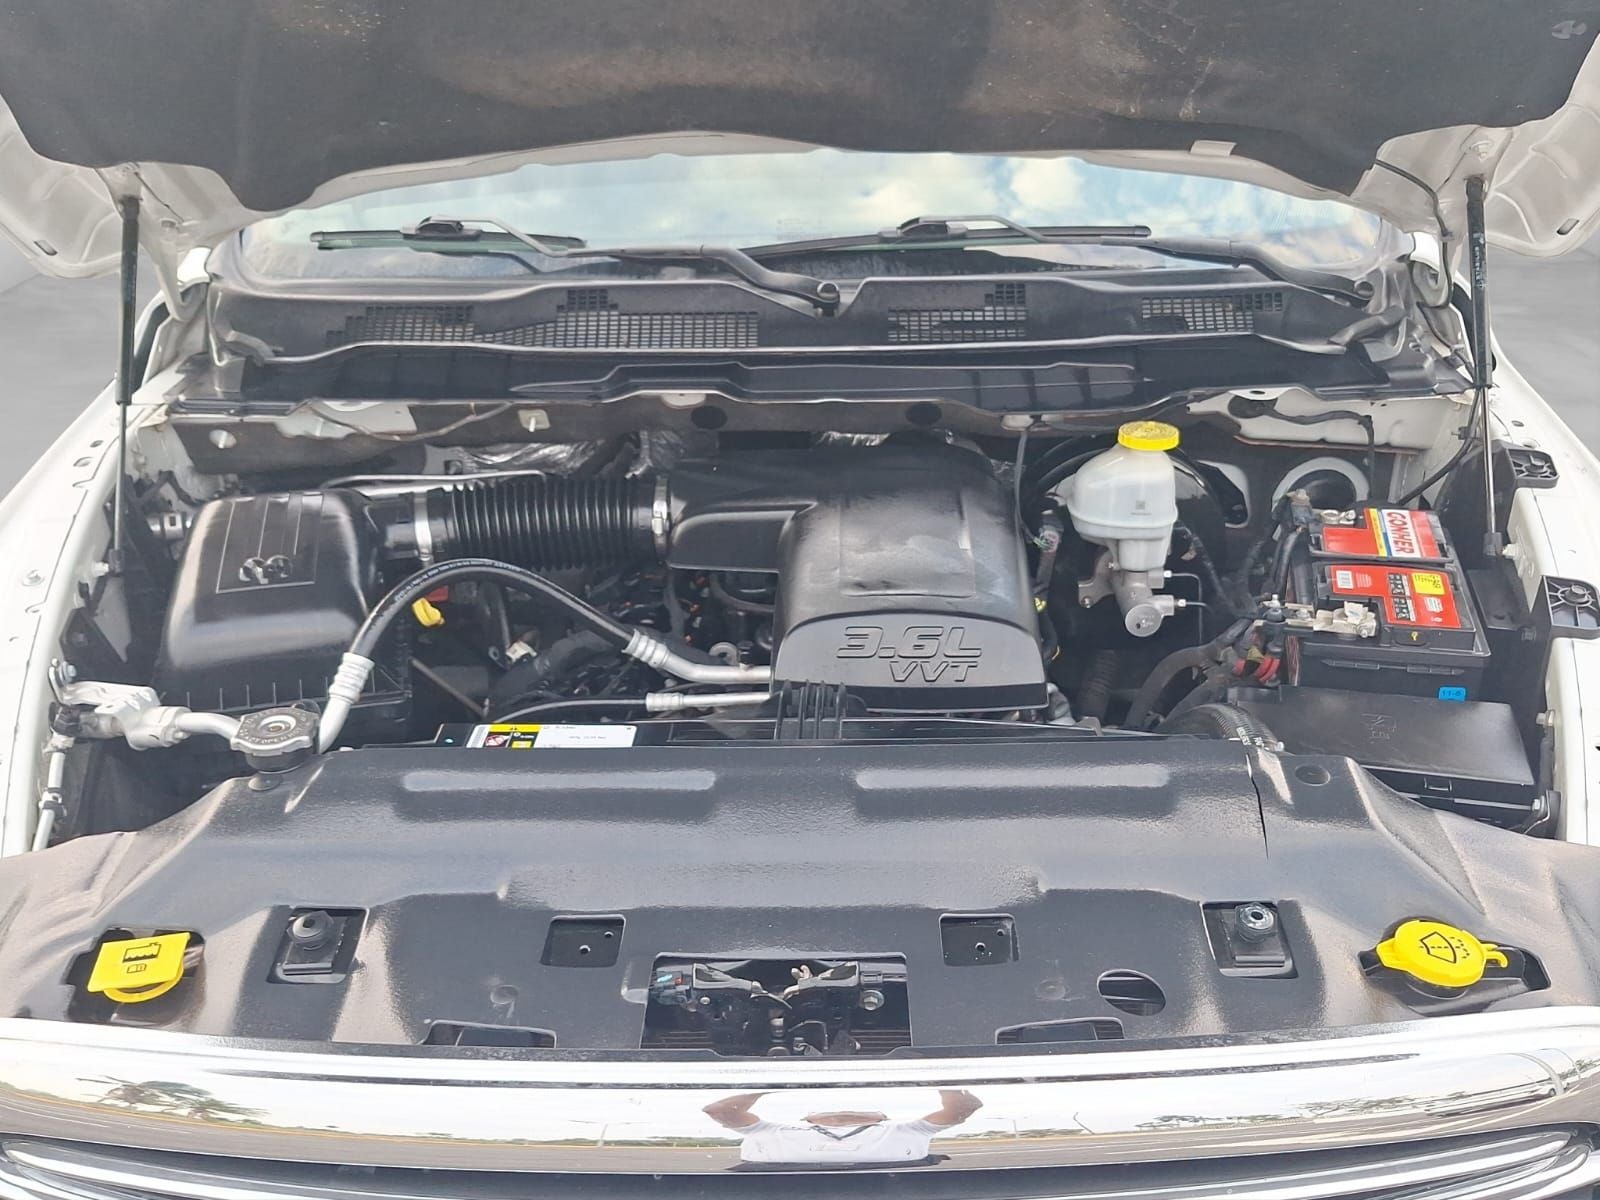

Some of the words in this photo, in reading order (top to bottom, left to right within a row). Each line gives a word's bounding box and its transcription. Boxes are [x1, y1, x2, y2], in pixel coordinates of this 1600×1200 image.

[1386, 511, 1414, 554] GONHER
[836, 625, 982, 659] 3.6L
[889, 660, 978, 683] VVT
